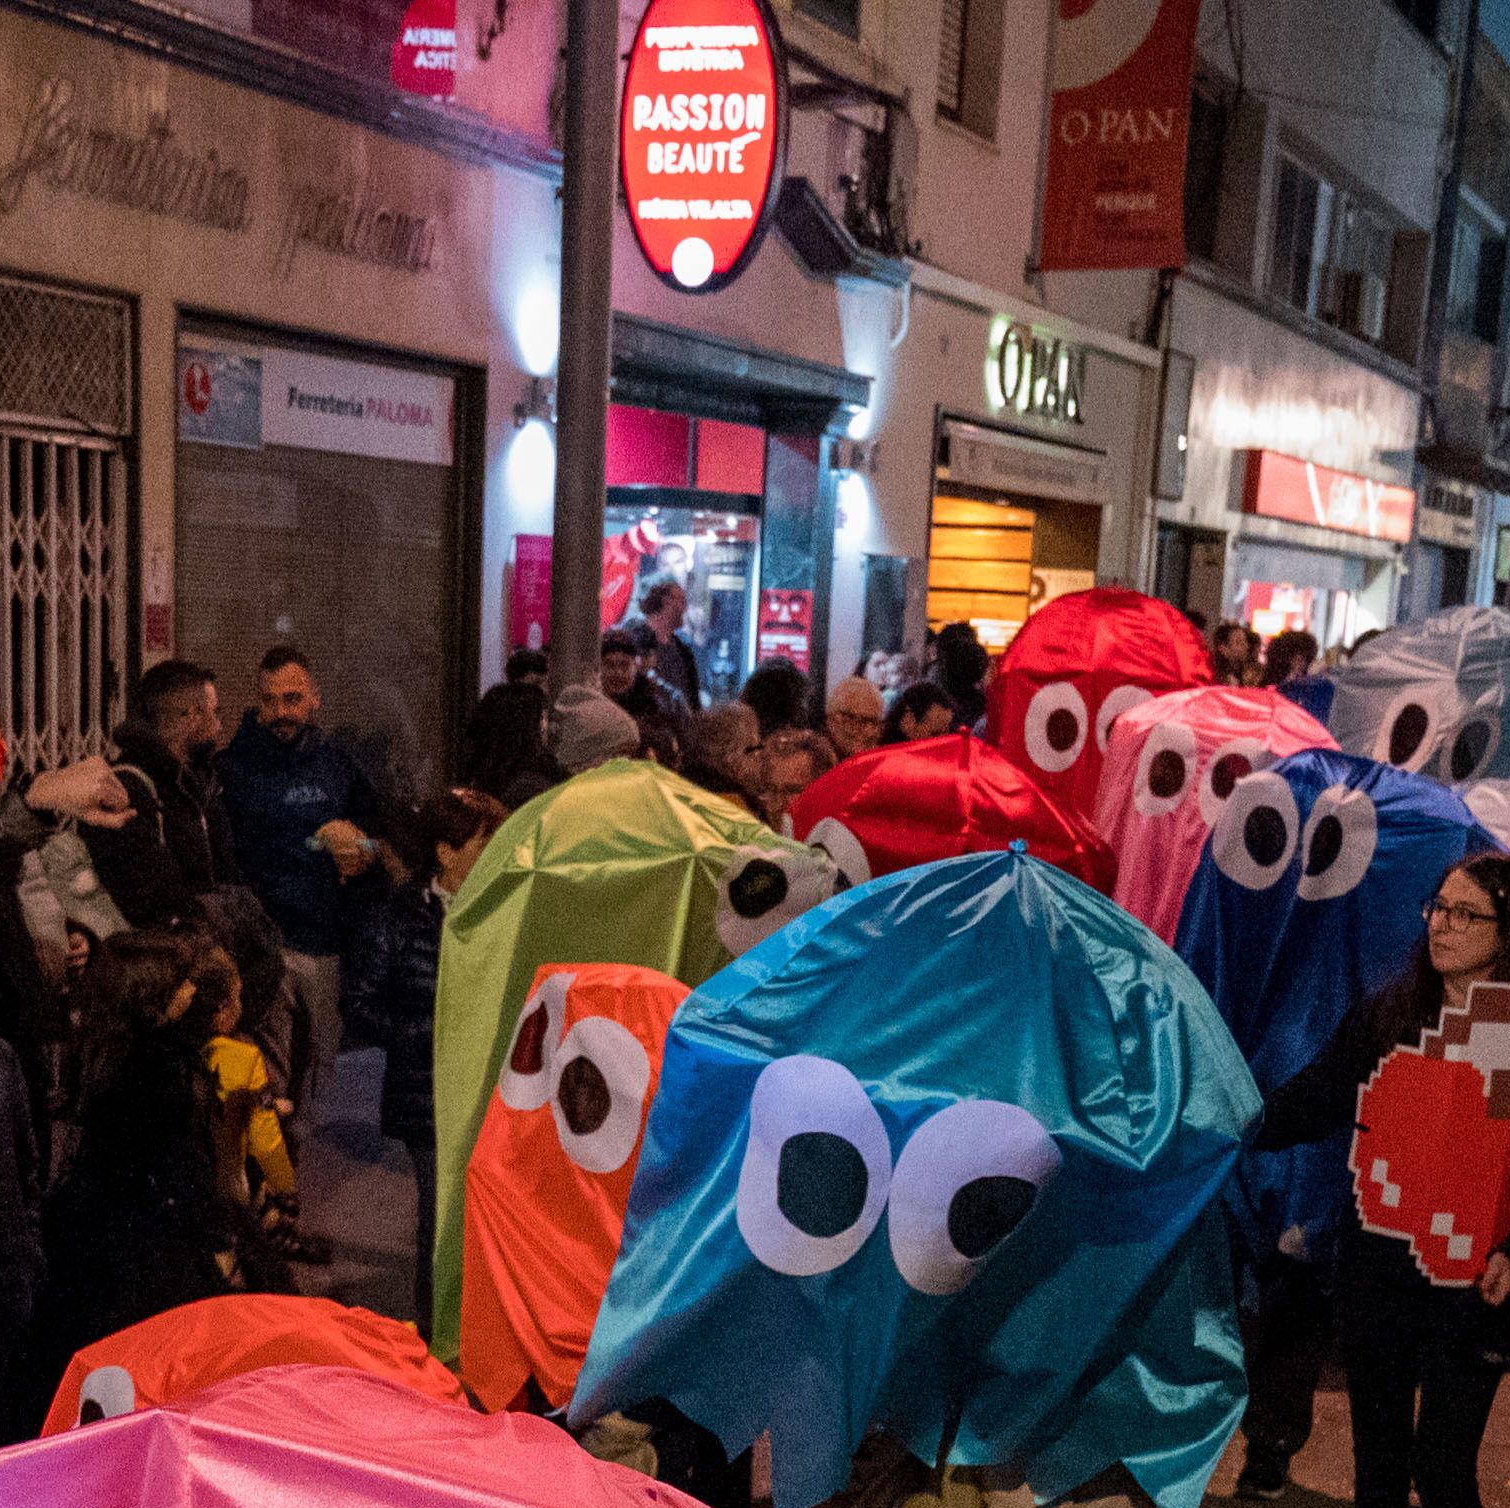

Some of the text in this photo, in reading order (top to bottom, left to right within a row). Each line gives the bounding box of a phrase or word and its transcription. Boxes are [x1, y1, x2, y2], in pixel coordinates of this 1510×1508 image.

[633, 93, 766, 130] PASSION
[647, 131, 762, 174] BEAUTÉ
[364, 398, 433, 427] PALOMA
